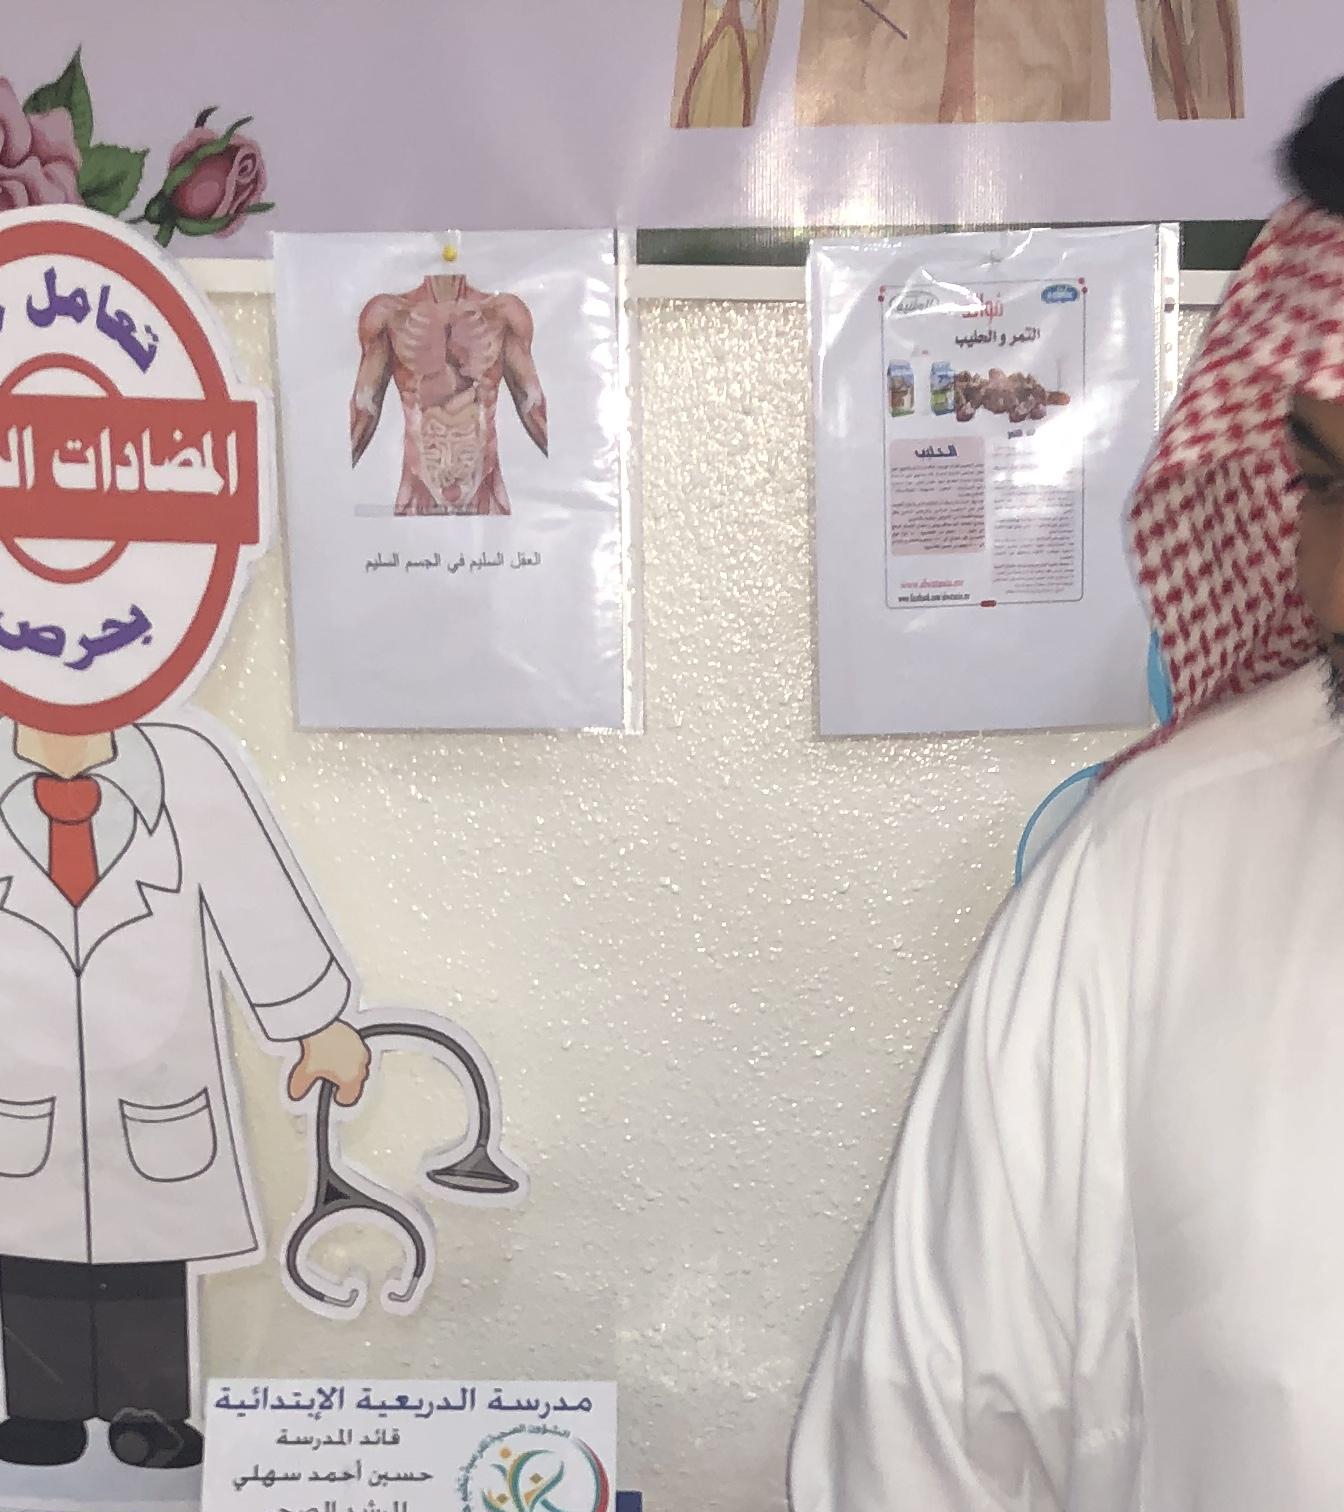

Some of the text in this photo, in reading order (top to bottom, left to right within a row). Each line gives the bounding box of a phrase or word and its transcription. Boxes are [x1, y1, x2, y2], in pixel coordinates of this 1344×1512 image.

[26, 267, 159, 374] تعامل
[52, 427, 237, 497] المضادات
[366, 552, 541, 574] العقل السليم في الجسم السليم
[356, 1386, 476, 1418] الدريعية
[488, 1388, 593, 1419] مدرسة
[276, 1428, 401, 1450] قائد المدرسة
[233, 1460, 433, 1491] حسين أحمد سهلي
